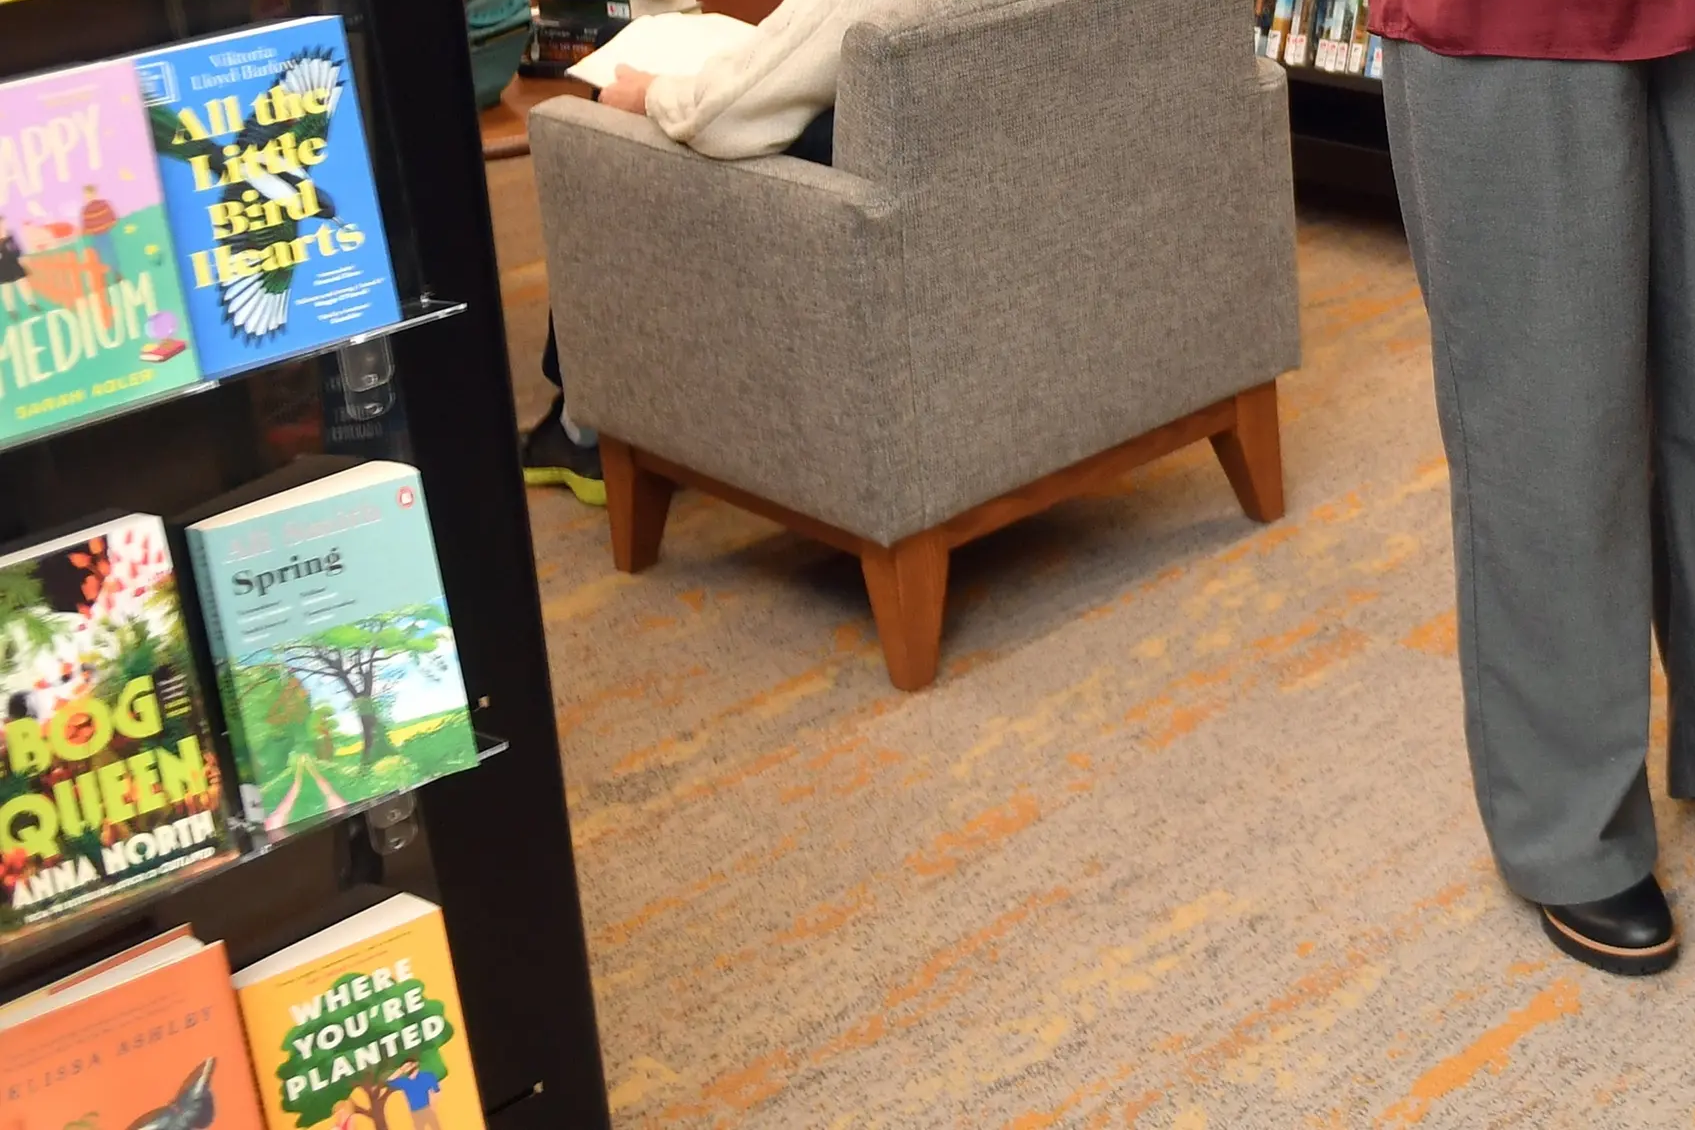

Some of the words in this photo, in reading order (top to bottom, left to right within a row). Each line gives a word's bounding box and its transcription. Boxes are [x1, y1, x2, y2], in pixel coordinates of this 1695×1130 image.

[171, 94, 244, 147] All
[252, 84, 331, 127] the
[187, 133, 328, 193] Little
[206, 178, 322, 241] Bird
[188, 223, 365, 290] Hearts
[15, 388, 85, 421] SARAH
[231, 546, 345, 599] Spring
[5, 675, 164, 776] BOG
[0, 734, 209, 858] QUEEN
[12, 847, 100, 910] ANNA
[103, 810, 215, 880] NORTH
[290, 957, 415, 1026] WHERE
[293, 987, 425, 1060] YOU'RE
[8, 1052, 101, 1101] ELISSA
[115, 1003, 214, 1056] ASHLEY
[286, 1014, 446, 1102] PLANTED
